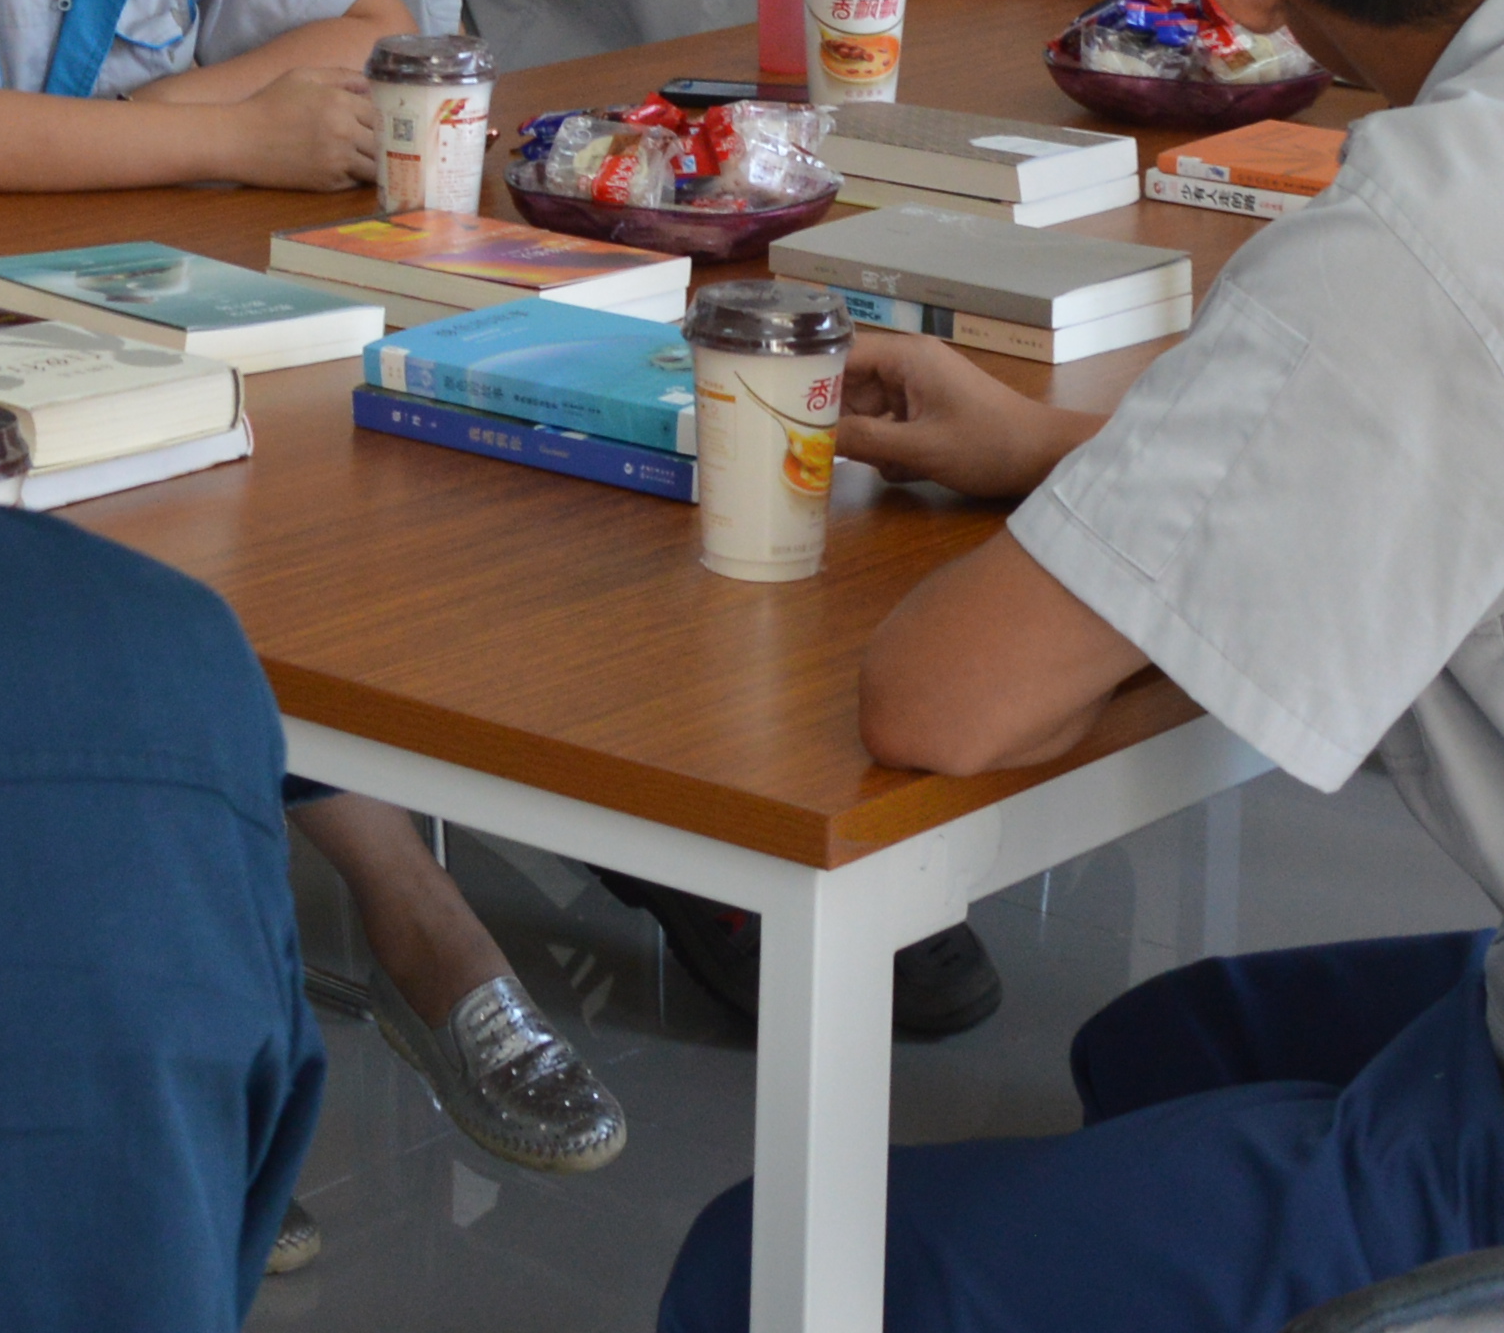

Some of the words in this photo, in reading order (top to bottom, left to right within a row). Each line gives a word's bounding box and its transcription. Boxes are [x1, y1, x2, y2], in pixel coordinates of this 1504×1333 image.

[1180, 183, 1257, 213] 少有人走的路
